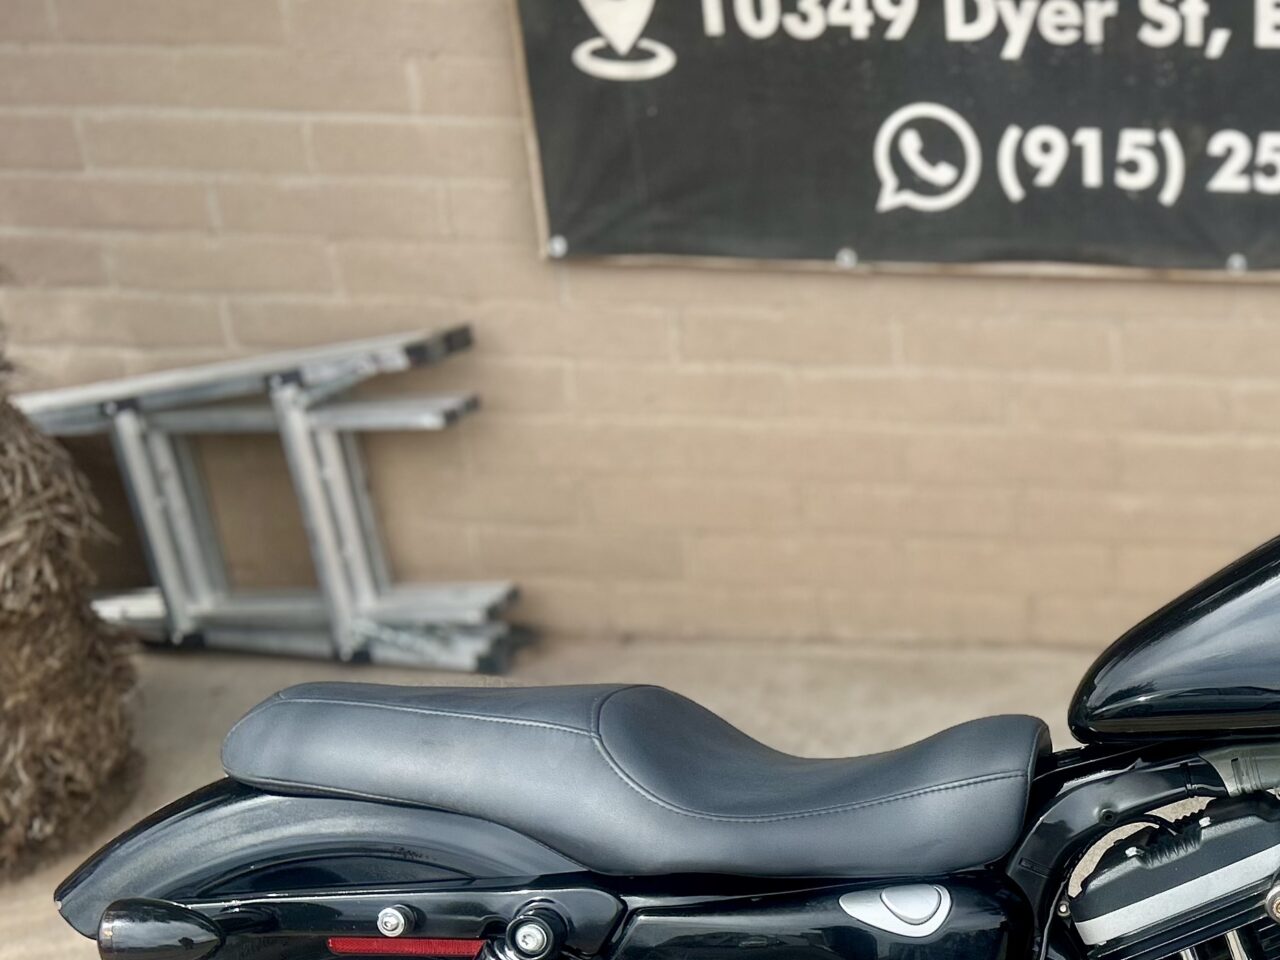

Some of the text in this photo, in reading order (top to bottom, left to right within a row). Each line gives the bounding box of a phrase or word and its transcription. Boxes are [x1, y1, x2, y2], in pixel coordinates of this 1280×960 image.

[700, 0, 919, 41] 10349
[943, 0, 1118, 61] Dyer
[1136, 0, 1232, 59] St,
[997, 124, 1186, 206] (915)
